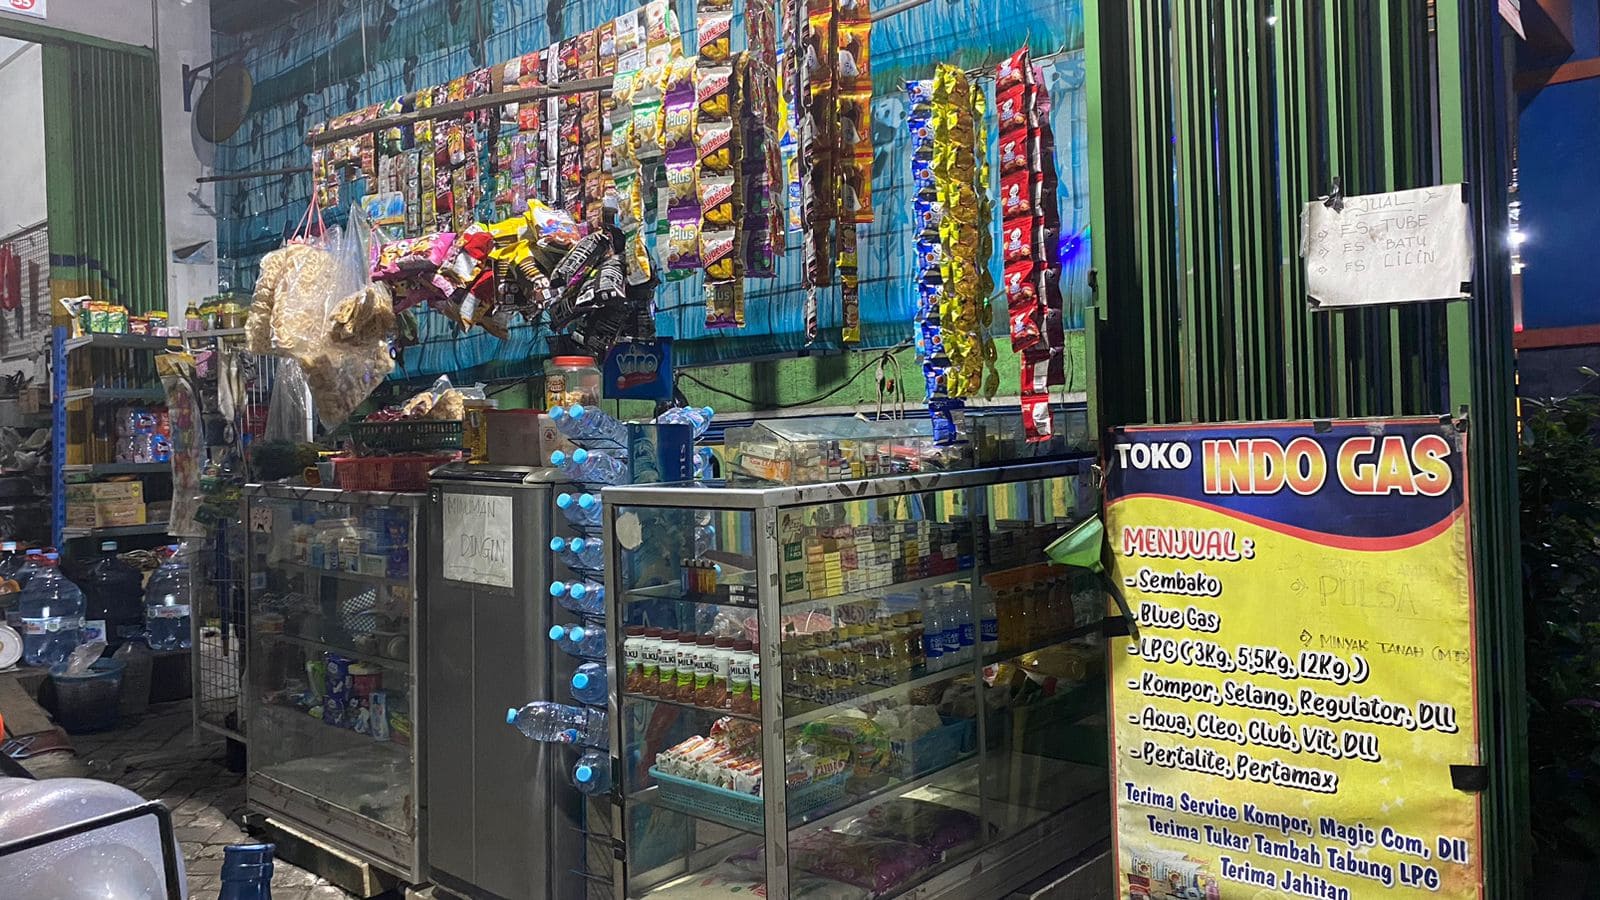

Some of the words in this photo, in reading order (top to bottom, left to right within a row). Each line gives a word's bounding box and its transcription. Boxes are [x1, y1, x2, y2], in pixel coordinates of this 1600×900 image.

[1350, 194, 1415, 213] JUAL
[1381, 213, 1429, 233] TUBE
[1114, 443, 1191, 469] TOKO
[1202, 436, 1327, 496] INDO
[1337, 434, 1453, 496] GAS
[1319, 575, 1418, 615] PULSA
[1187, 607, 1216, 628] Gas
[1319, 634, 1369, 651] MINYAK
[1376, 641, 1424, 656] TANAH
[1237, 755, 1334, 788] Pertamax
[1125, 783, 1174, 809] Terima
[1180, 792, 1237, 820] Service
[1243, 804, 1313, 835] Kompor,
[1319, 817, 1374, 846] Magic
[1380, 827, 1430, 858] Com,
[1438, 838, 1467, 863] Dll
[1147, 815, 1199, 841] Terima
[1203, 825, 1250, 850] Tukar
[1254, 834, 1321, 865] Tambah
[1326, 848, 1392, 885] Tabung
[1400, 862, 1438, 889] LPG
[1221, 857, 1275, 887] Terima
[1281, 870, 1348, 900] Jahitan
